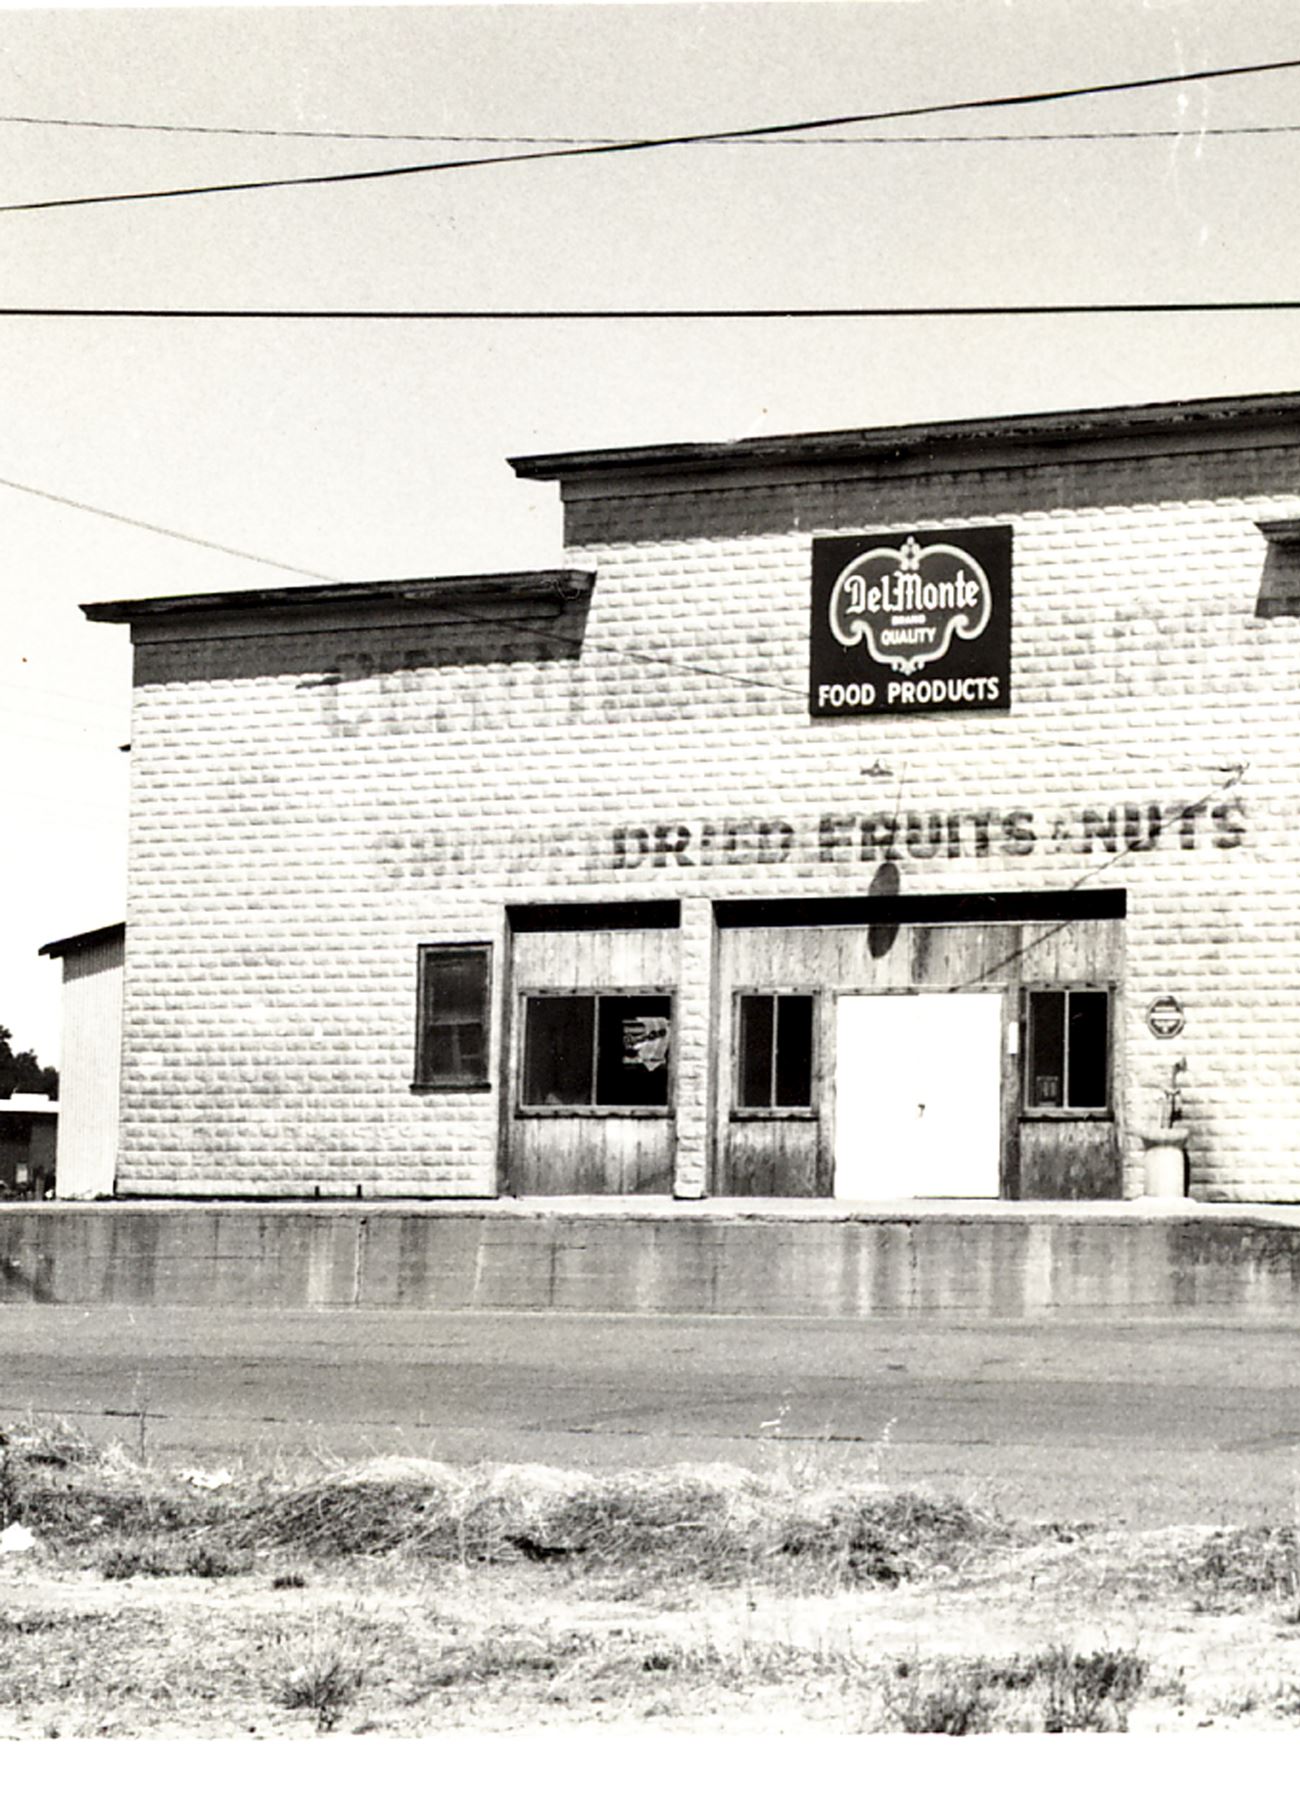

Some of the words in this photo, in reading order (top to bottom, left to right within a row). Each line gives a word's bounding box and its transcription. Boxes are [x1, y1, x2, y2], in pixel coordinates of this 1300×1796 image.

[881, 627, 936, 646] QUALITY
[818, 683, 876, 707] FOOD
[887, 677, 999, 704] PRODUCTS
[612, 820, 795, 870] DRIED
[818, 809, 1037, 863] FRUITS
[1079, 801, 1246, 855] NUTS
